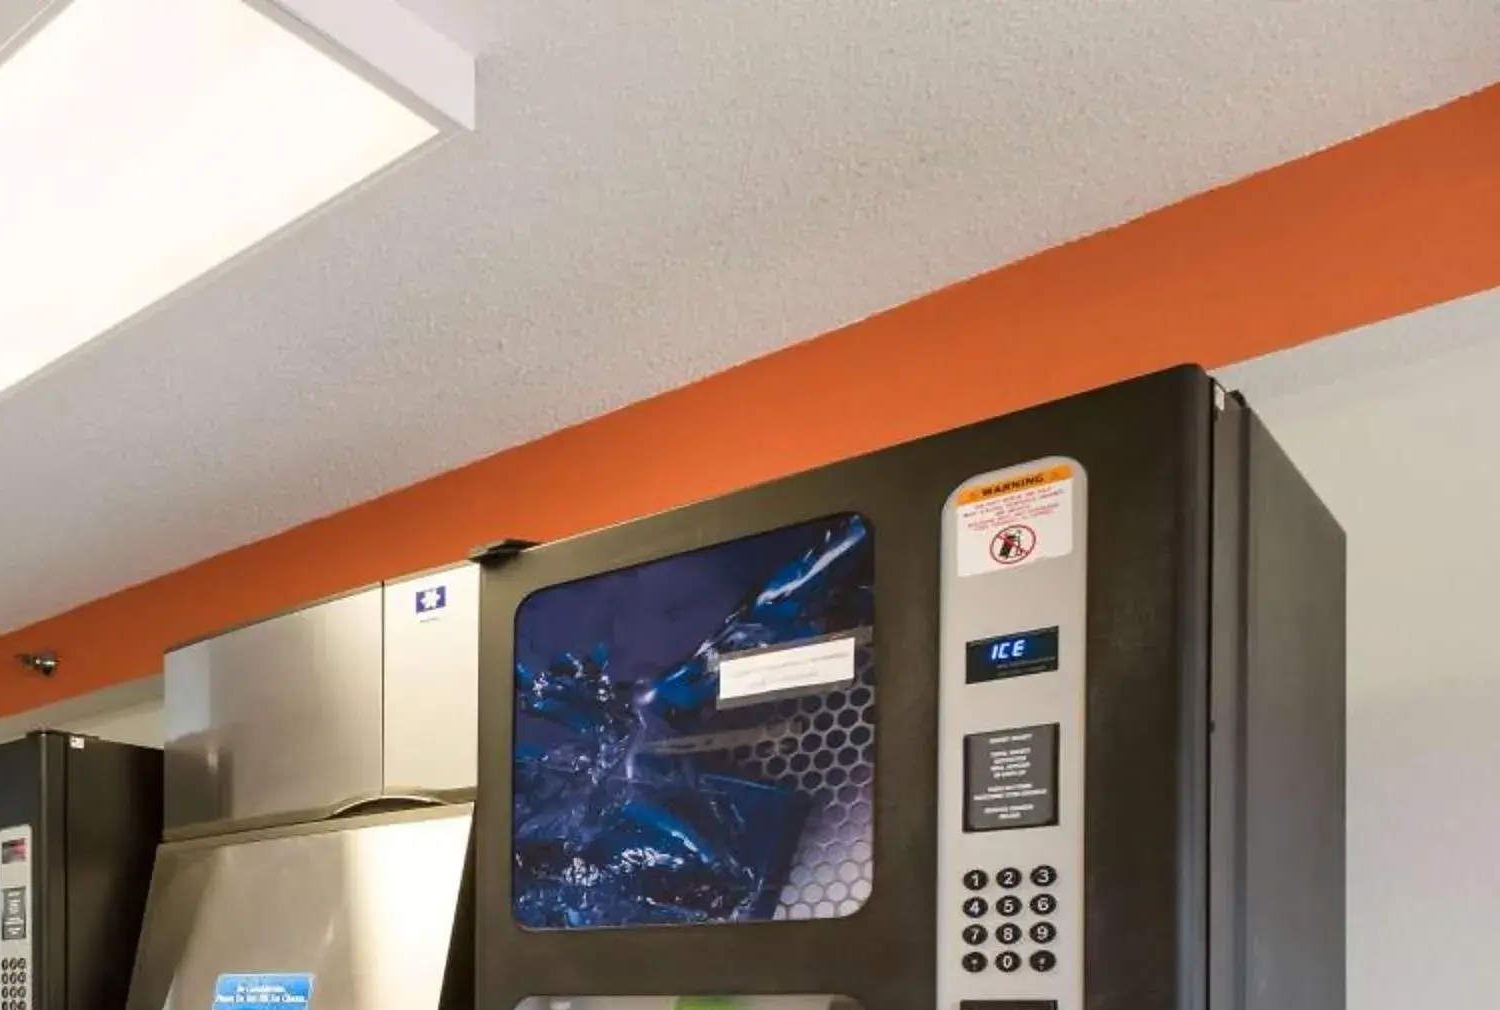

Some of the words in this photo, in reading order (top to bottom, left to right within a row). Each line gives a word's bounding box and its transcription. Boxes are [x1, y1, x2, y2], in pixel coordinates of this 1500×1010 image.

[981, 472, 1045, 497] WARNING
[991, 639, 1026, 661] ICE
[971, 872, 979, 887] 1
[1003, 871, 1013, 885] 2
[1036, 868, 1050, 883] 3
[969, 900, 980, 915] 4
[1003, 899, 1014, 913] 5
[1036, 897, 1049, 911] 6
[971, 927, 980, 942] 7
[1003, 927, 1013, 941] 8
[1036, 925, 1049, 940] 9
[1003, 955, 1013, 969] 0
